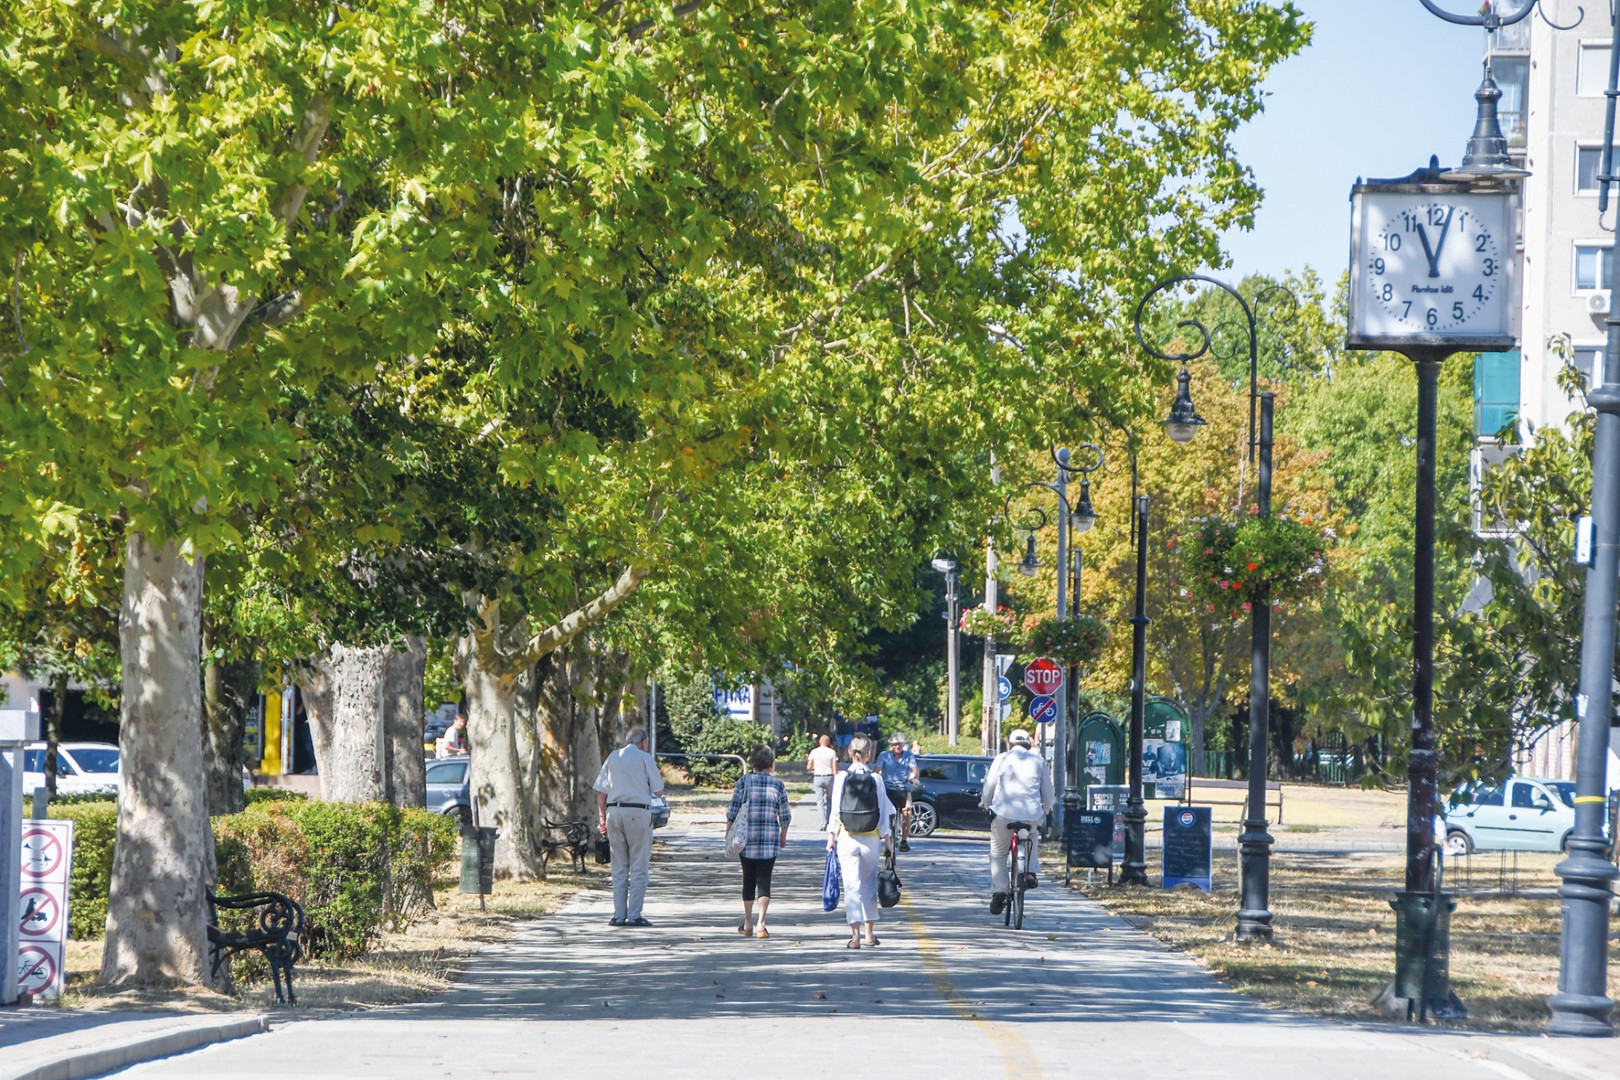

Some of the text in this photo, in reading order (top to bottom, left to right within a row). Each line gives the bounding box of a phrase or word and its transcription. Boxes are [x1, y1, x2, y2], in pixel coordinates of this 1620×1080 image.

[1404, 214, 1417, 232] 11
[1427, 207, 1444, 226] 12
[1459, 215, 1464, 232] 1
[1383, 233, 1401, 251] 10
[1476, 234, 1486, 252] 2
[1374, 257, 1385, 275] 9
[1482, 258, 1493, 276] 3
[1382, 283, 1393, 301] 8
[1472, 284, 1483, 302] 4
[1402, 301, 1412, 318] 7
[1426, 307, 1437, 325] 6
[1452, 301, 1463, 320] 5
[1027, 669, 1060, 684] STOP
